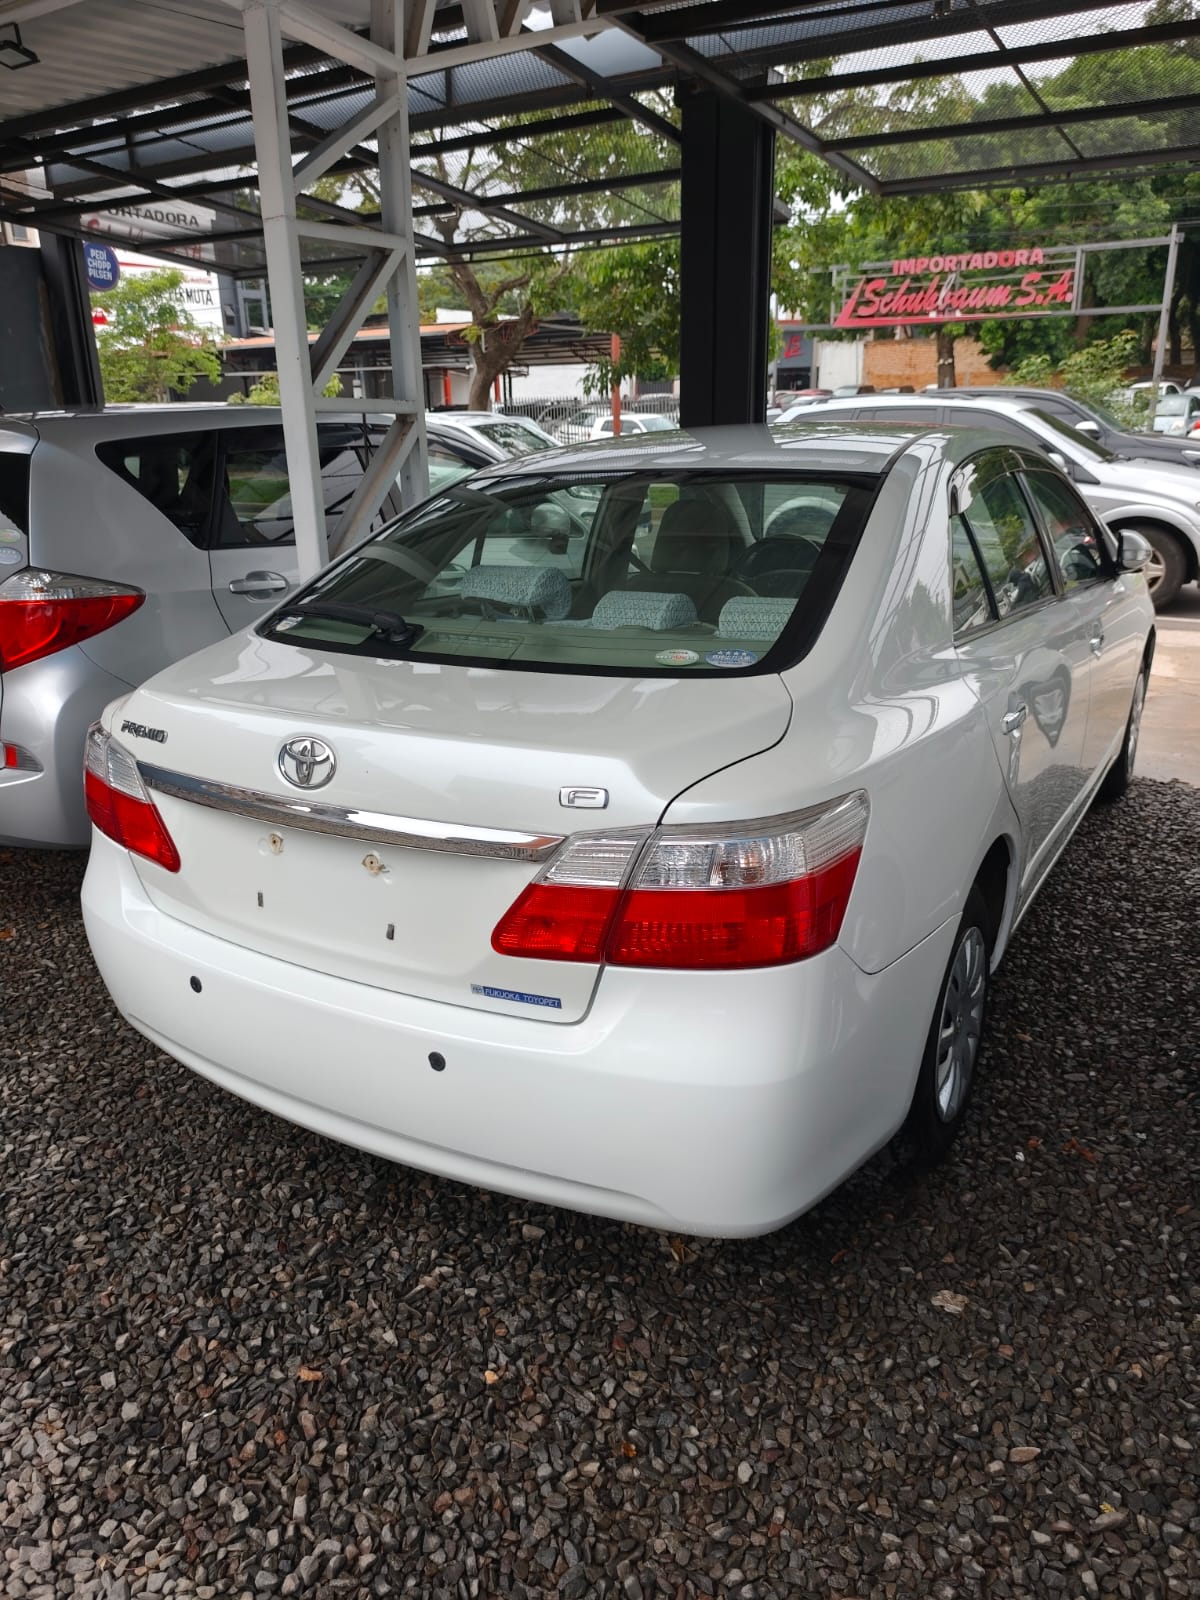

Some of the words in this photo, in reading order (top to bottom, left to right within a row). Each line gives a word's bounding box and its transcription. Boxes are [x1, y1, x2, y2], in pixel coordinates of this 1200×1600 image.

[87, 257, 112, 271] CHOPP
[892, 249, 1044, 275] IMPORTADORA
[88, 268, 113, 281] PILSEN
[1015, 270, 1074, 306] S.A.
[120, 719, 168, 744] PREMIO
[484, 987, 520, 1001] FUKUOKA
[523, 994, 560, 1008] TOYOPET
